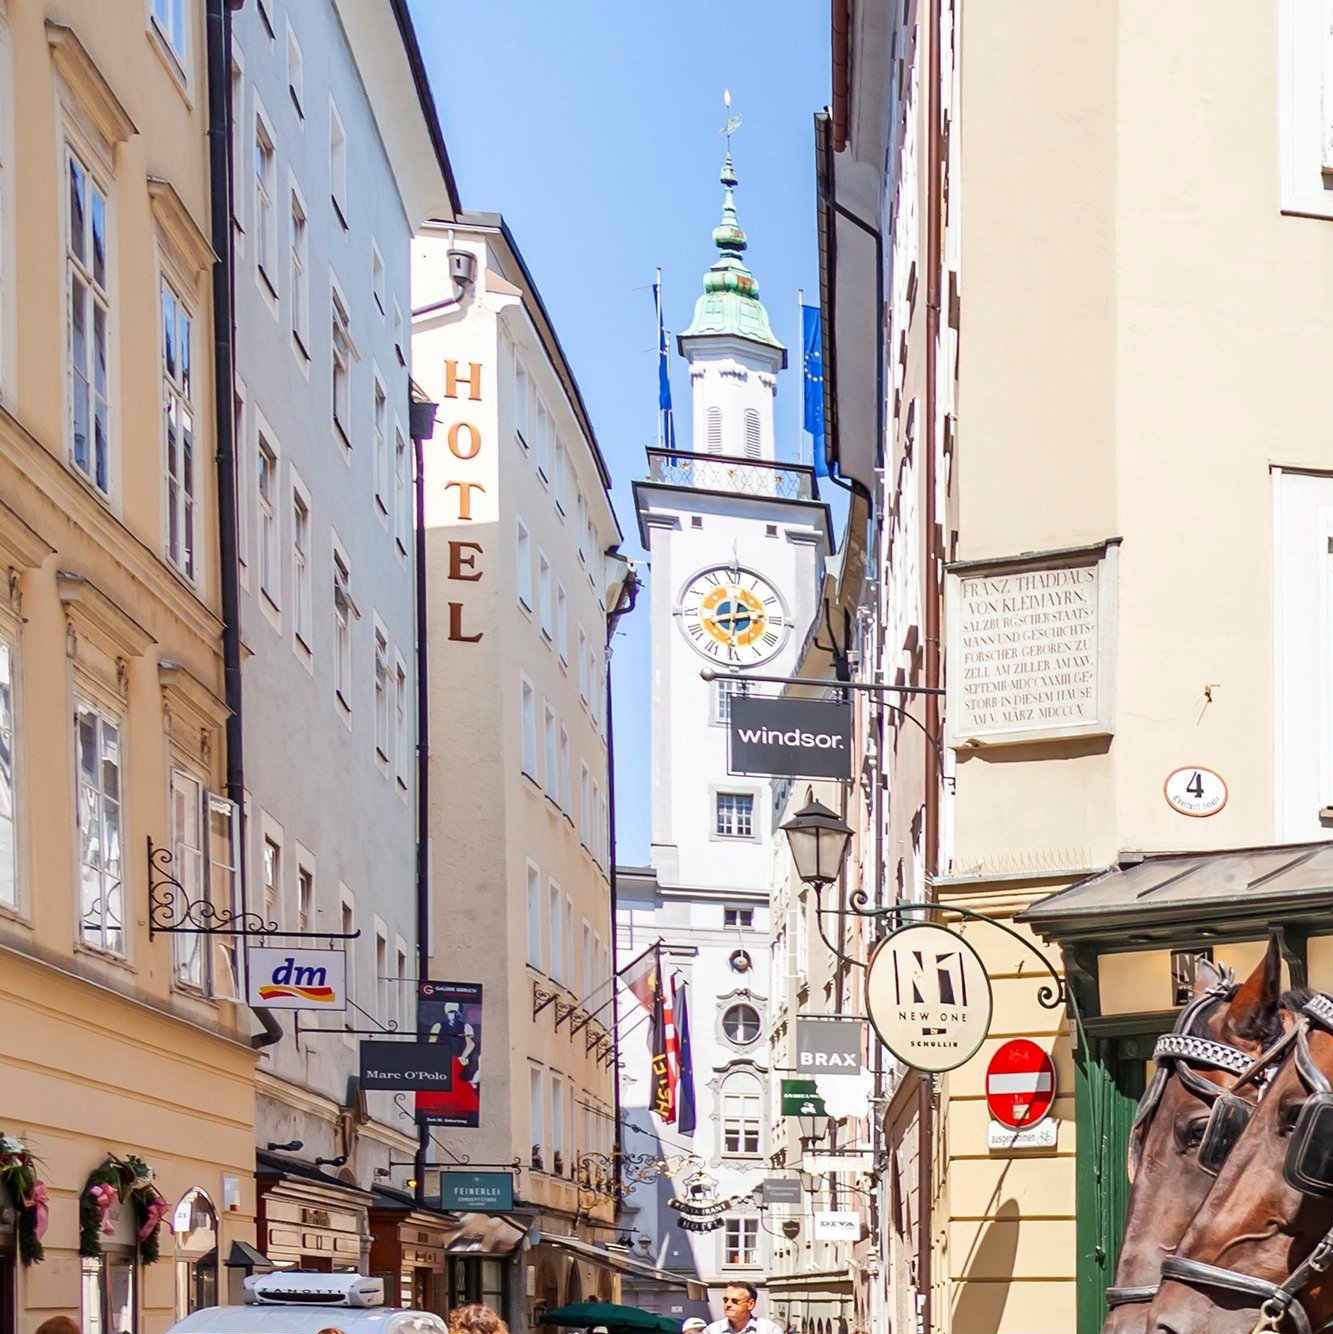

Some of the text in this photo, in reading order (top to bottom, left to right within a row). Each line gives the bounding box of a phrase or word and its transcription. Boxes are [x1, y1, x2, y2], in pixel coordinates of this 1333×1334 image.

[444, 359, 486, 643] HOTEL
[963, 579, 1010, 598] FRANZ
[969, 602, 998, 615] VON
[963, 634, 996, 648] MANN
[998, 631, 1020, 643] UND
[964, 639, 1092, 663] FORSCHER GEBOREN ZU
[964, 666, 991, 680] ZELL
[996, 664, 1010, 676] AM
[1013, 661, 1051, 674] ZILLER
[1055, 658, 1070, 670] AM
[1014, 692, 1053, 706] DIESEM
[1057, 687, 1093, 700] HAUSE
[973, 714, 986, 725] AM
[738, 727, 844, 749] windsor.
[1187, 771, 1204, 798] 4
[272, 958, 327, 986] dm
[899, 1011, 967, 1022] NEW ONE
[800, 1052, 857, 1066] BRAX
[366, 1070, 448, 1080] Marc O'Polo
[454, 1187, 501, 1196] FEINERLEI
